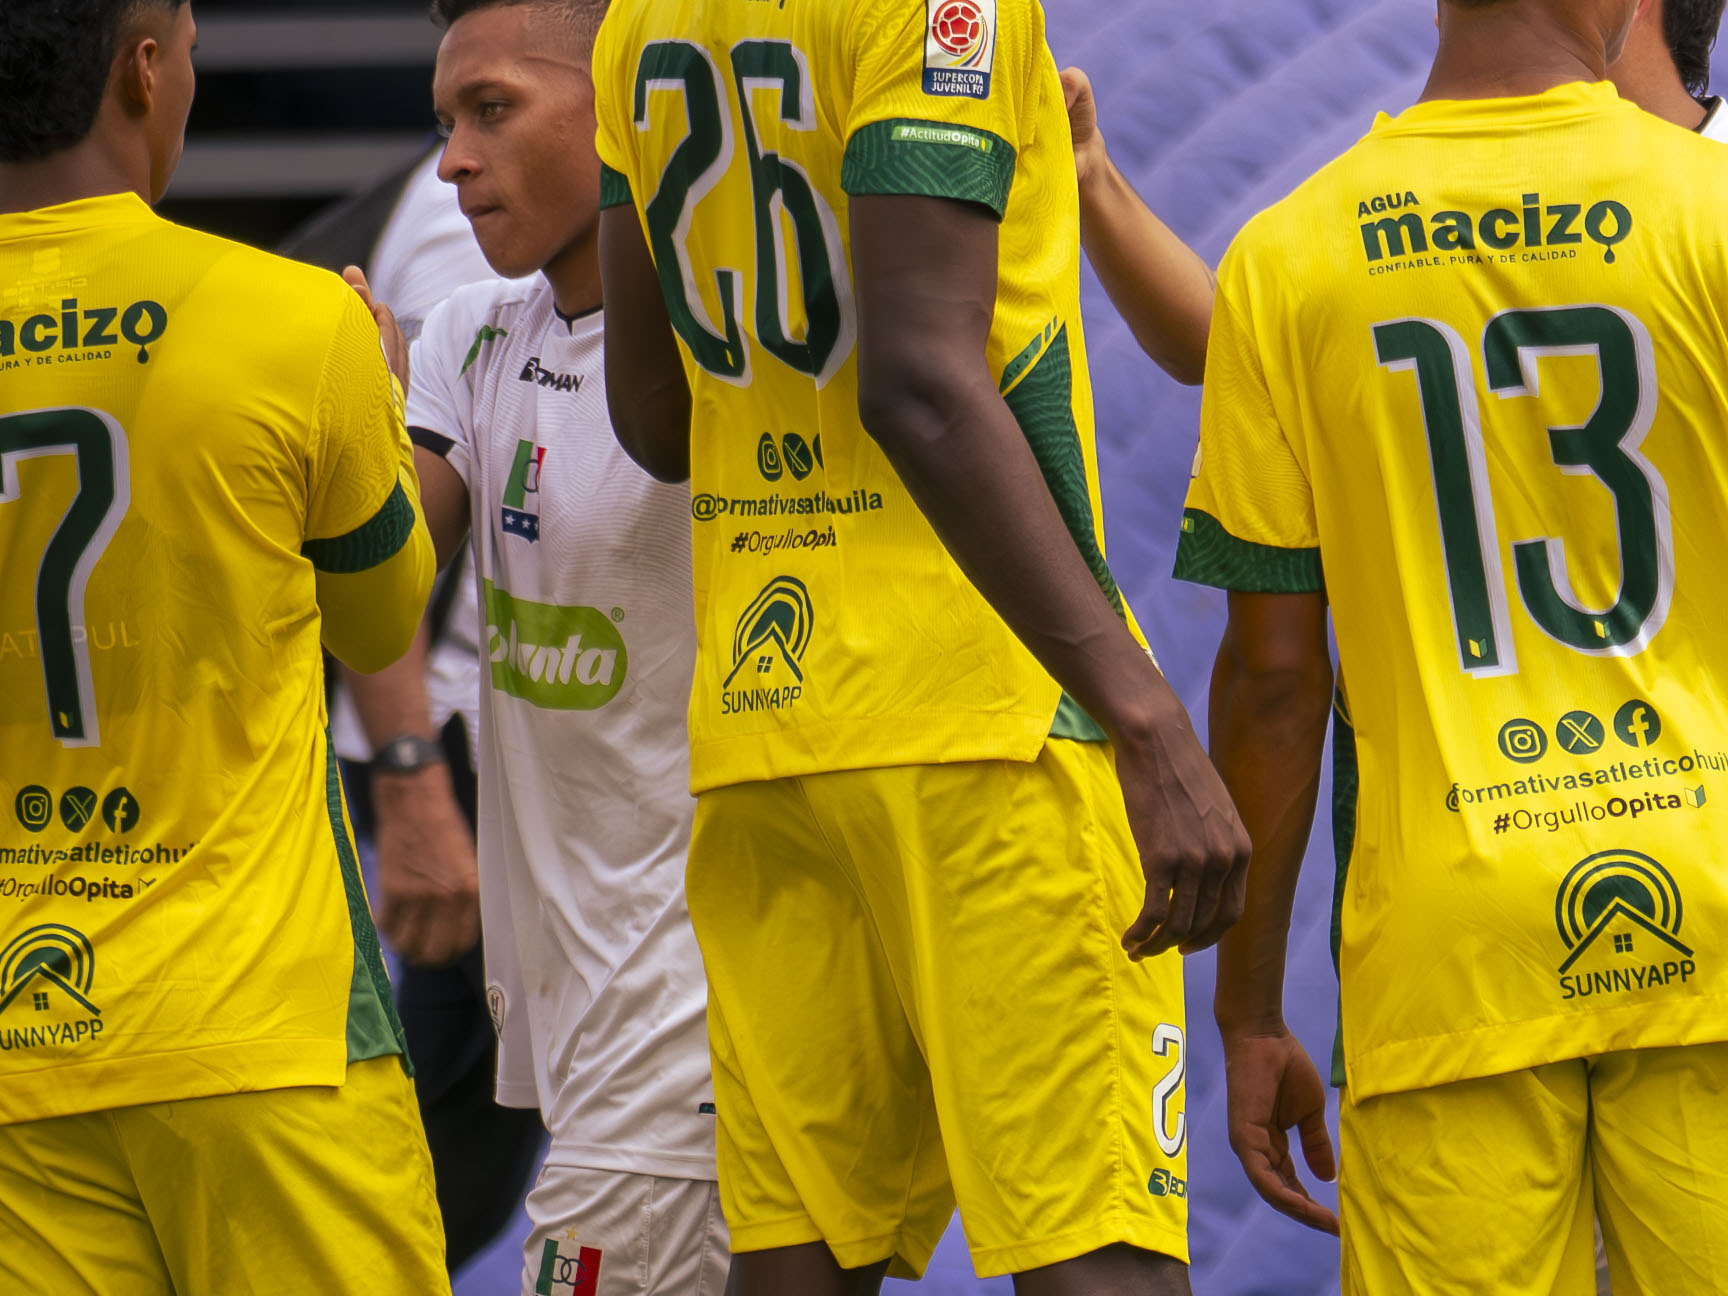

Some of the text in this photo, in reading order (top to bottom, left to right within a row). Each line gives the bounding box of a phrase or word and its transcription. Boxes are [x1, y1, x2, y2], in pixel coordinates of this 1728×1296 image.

[931, 82, 971, 94] JUVENIL
[932, 71, 984, 85] SUPERCOPA
[634, 40, 857, 388] 26
[1357, 191, 1420, 218] AGUA
[1360, 193, 1632, 264] macizo
[1450, 254, 1483, 265] PURA
[1487, 254, 1495, 264] Y
[1500, 253, 1516, 264] DE
[1521, 249, 1577, 262] CALIDAD
[25, 357, 32, 367] Y
[37, 355, 53, 366] DE
[57, 350, 112, 364] CALIDAD
[1370, 303, 1676, 679] 13
[0, 407, 131, 748] 7
[721, 685, 803, 715] SUNNYAPP
[1493, 791, 1682, 835] #OrgulloOpita
[1559, 959, 1696, 1000] SUNNYAPP
